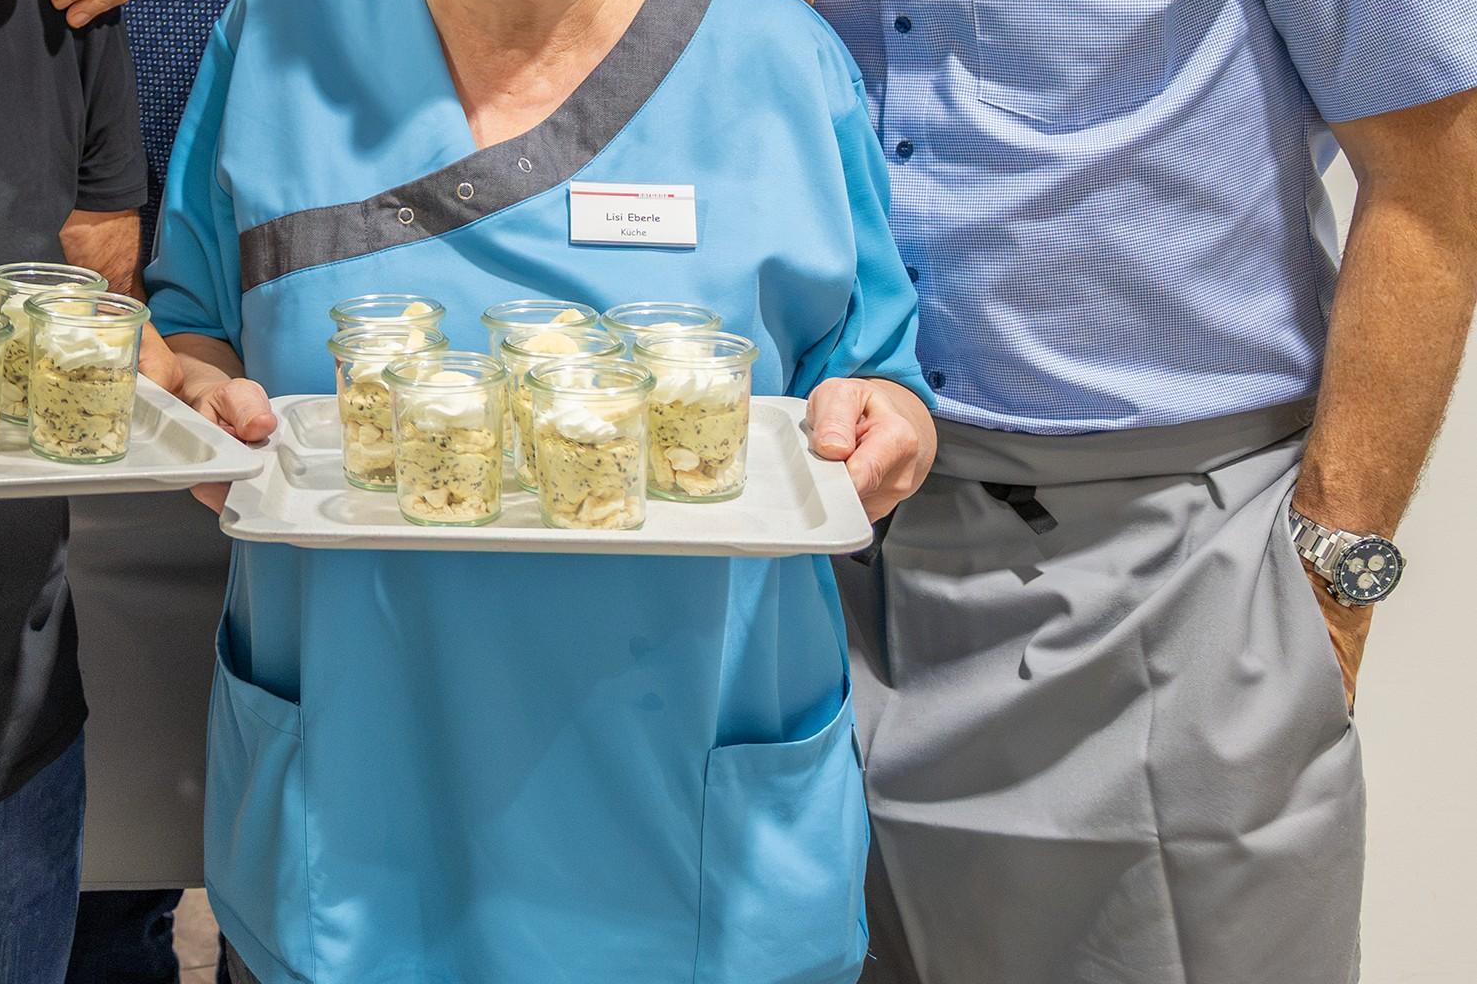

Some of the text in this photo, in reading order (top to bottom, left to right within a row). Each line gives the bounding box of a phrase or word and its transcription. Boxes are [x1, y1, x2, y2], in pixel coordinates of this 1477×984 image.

[606, 212, 661, 223] Lisi Eberle
[620, 227, 647, 237] Küche
